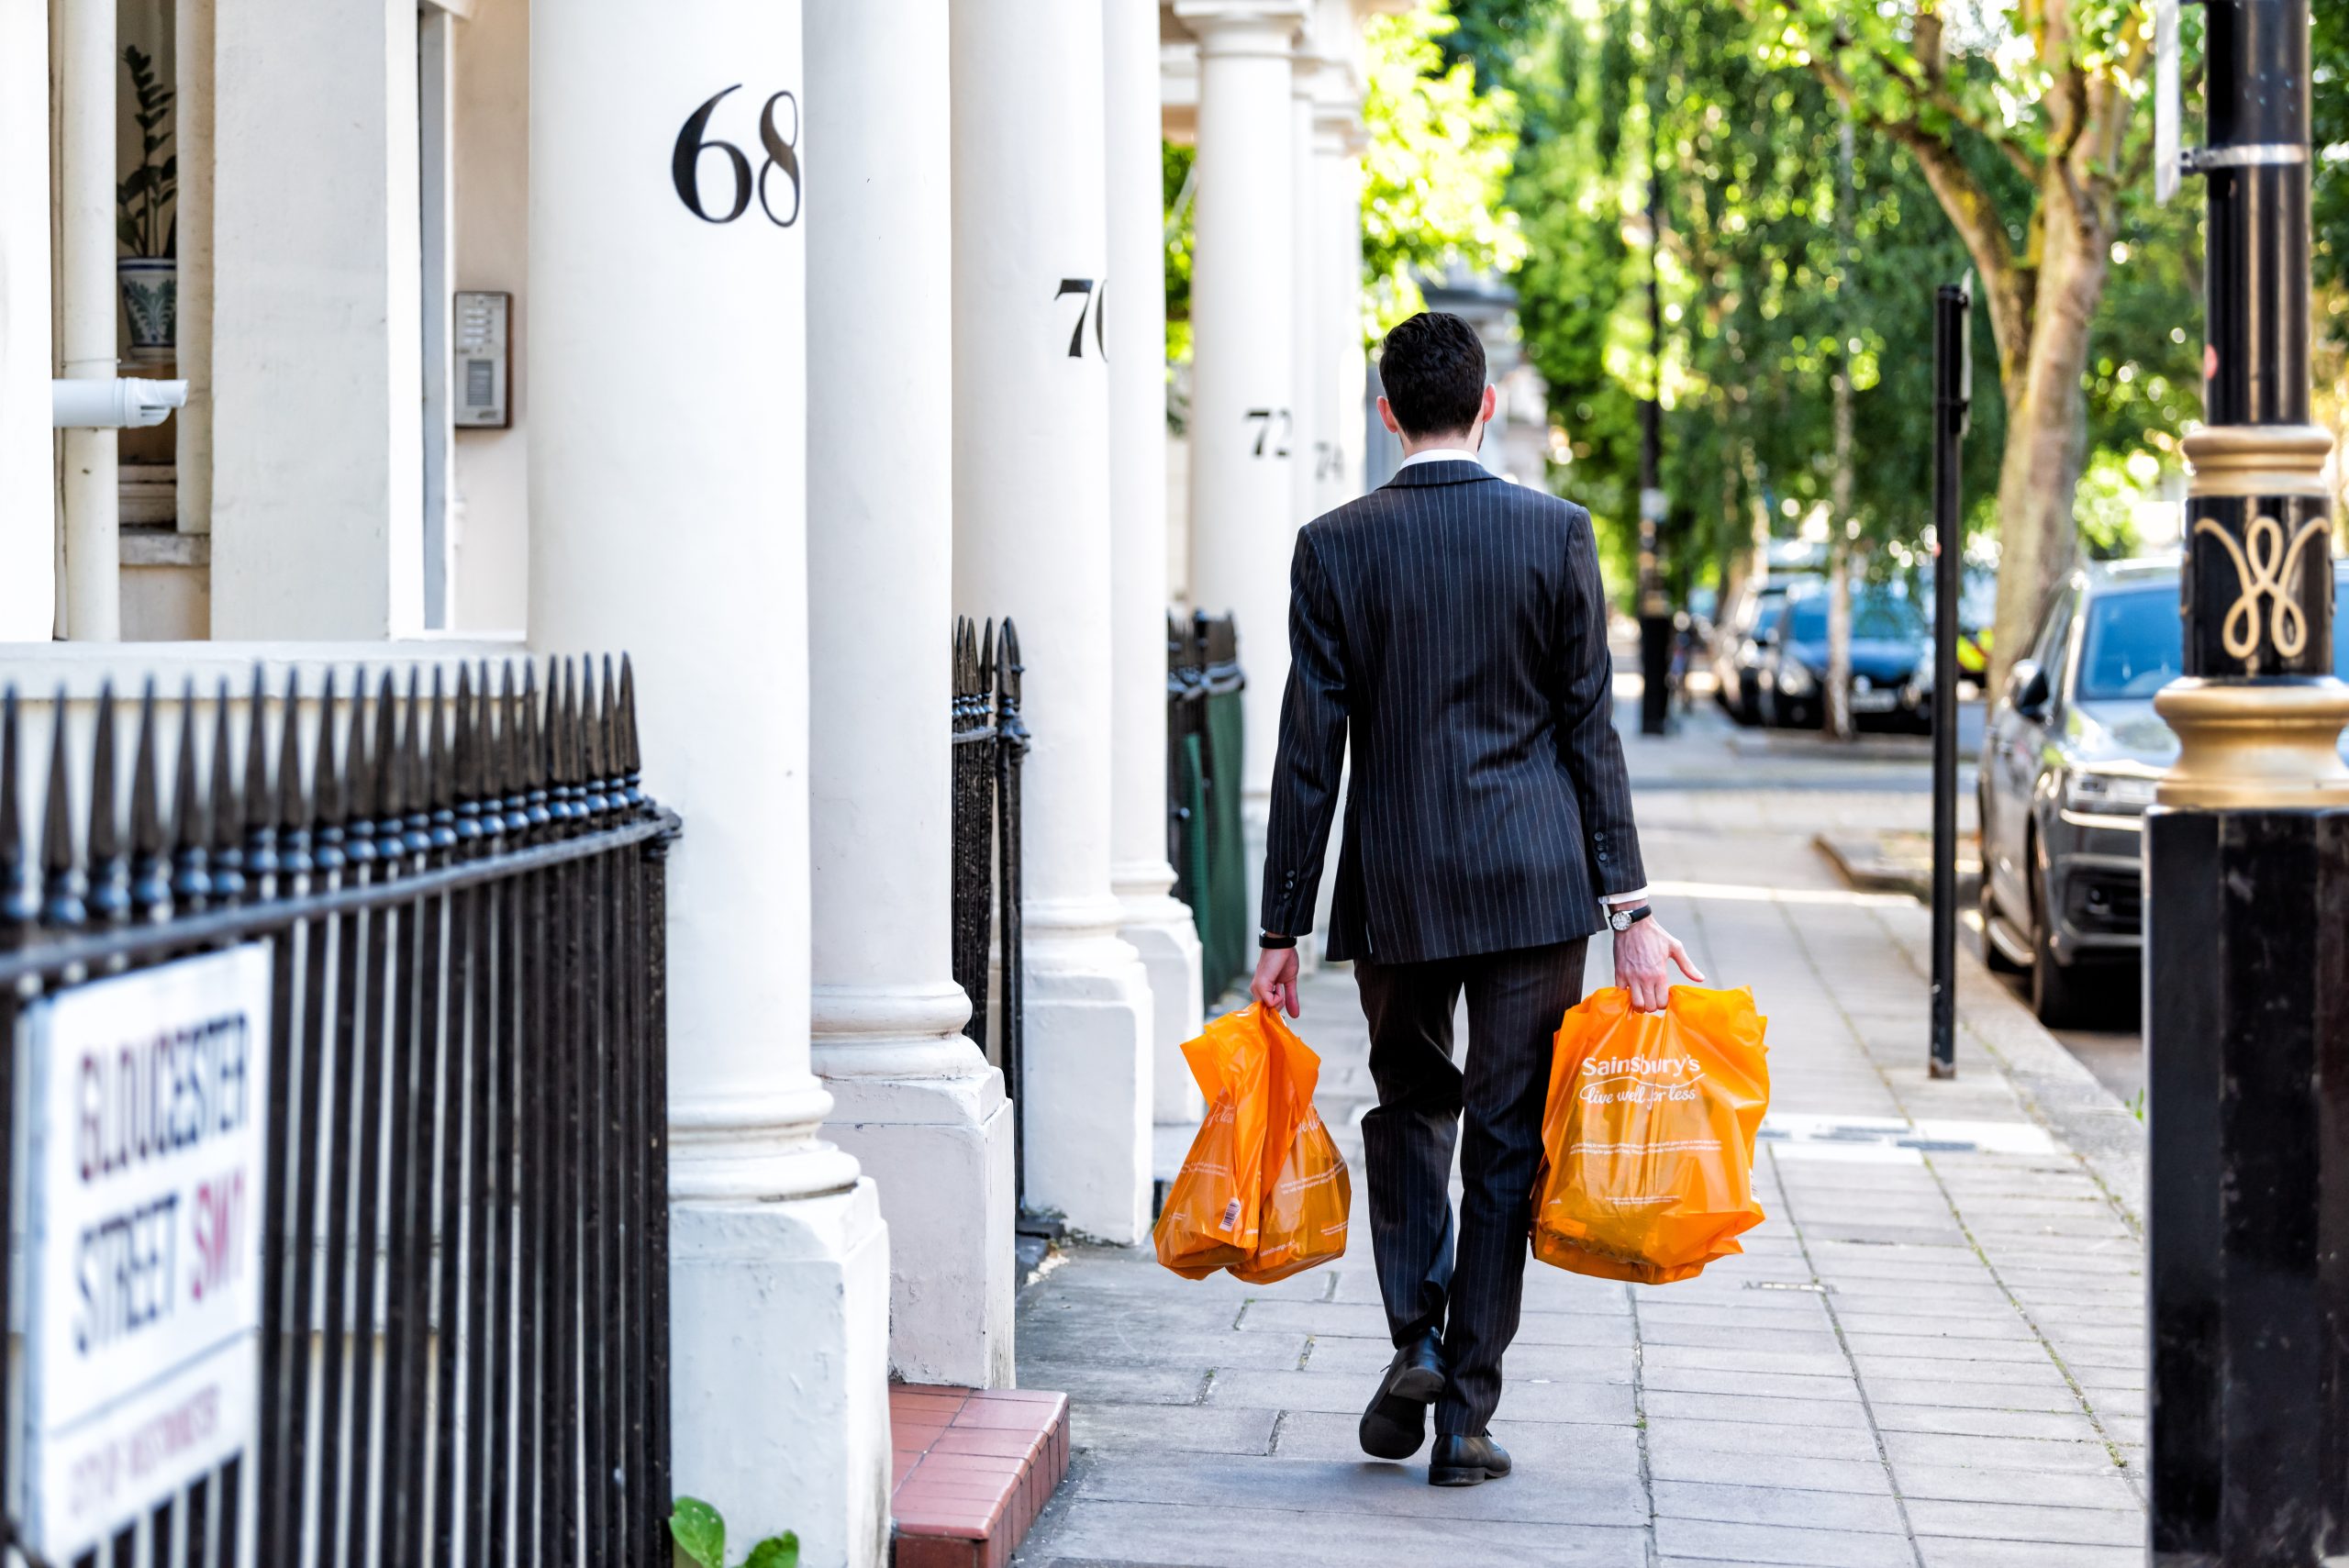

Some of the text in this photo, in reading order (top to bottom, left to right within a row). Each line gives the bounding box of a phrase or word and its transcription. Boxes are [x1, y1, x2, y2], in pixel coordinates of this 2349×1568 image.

[672, 83, 801, 228] 68
[1241, 407, 1292, 459] 72
[76, 1010, 250, 1184] GLOUCESTER
[1581, 1053, 1701, 1078] Sainsbury's
[1617, 1084, 1645, 1104] well
[1668, 1084, 1697, 1102] less
[74, 1192, 180, 1356] STREET
